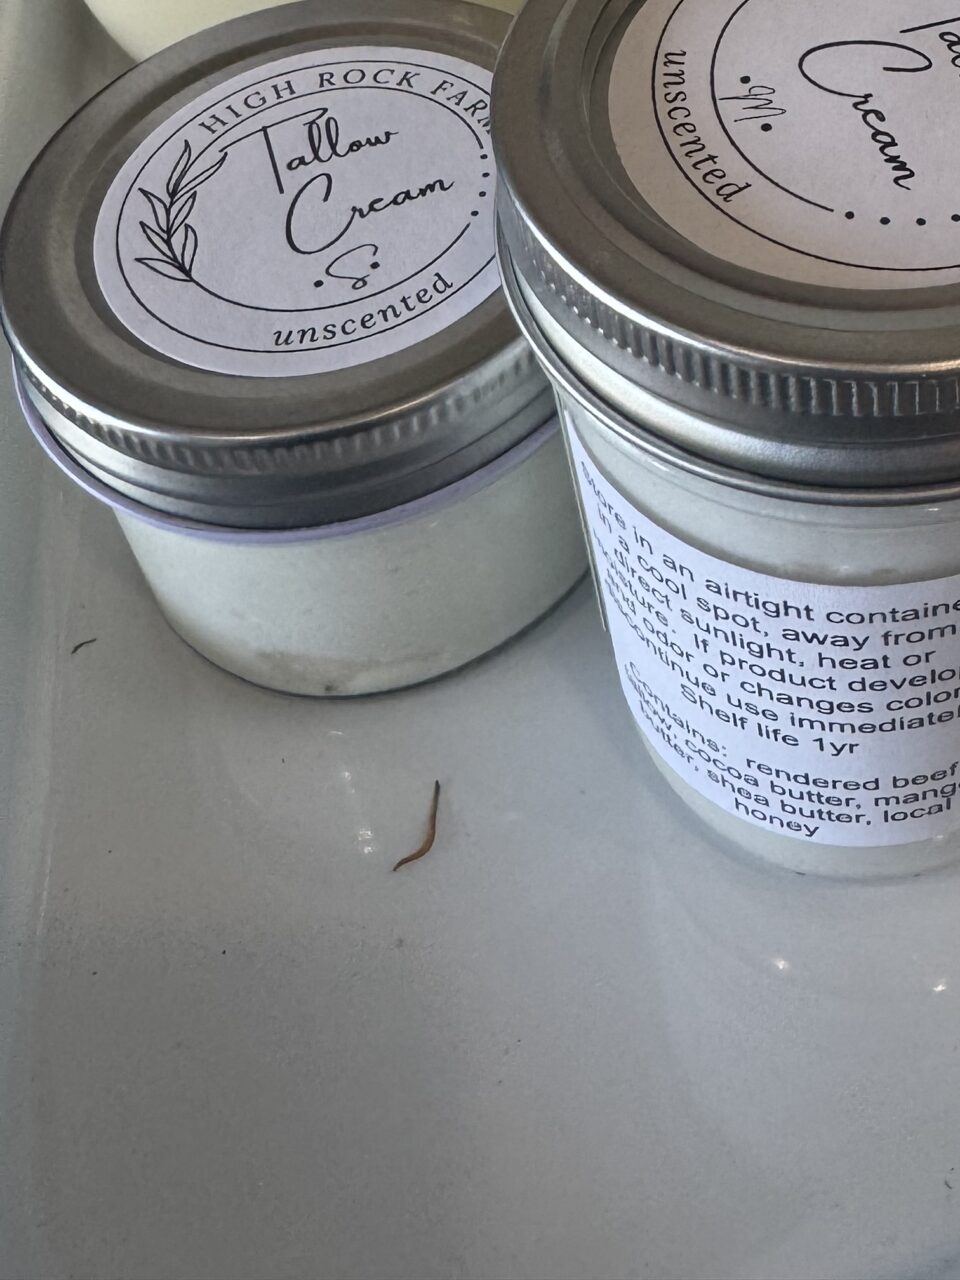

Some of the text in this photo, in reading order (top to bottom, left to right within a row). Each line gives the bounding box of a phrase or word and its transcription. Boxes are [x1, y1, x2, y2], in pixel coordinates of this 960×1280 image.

[198, 80, 296, 135] HIGH
[318, 68, 421, 89] ROCK
[662, 48, 753, 203] unscented
[799, 40, 932, 191] Cream
[219, 107, 399, 194] Tallow
[285, 172, 455, 254] Cream
[273, 272, 454, 347] unscented
[614, 548, 936, 670] direct sunlight, heat or
[618, 535, 630, 554] a
[637, 555, 687, 600] cool
[697, 597, 769, 637] spot,
[782, 628, 870, 651] away
[881, 624, 957, 646] from
[633, 526, 653, 555] in
[662, 554, 694, 582] an
[705, 579, 815, 620] airtight
[643, 618, 695, 662] odor
[703, 663, 730, 682] or
[740, 681, 874, 715] changes
[694, 633, 709, 653] If
[720, 650, 837, 691] product
[629, 661, 959, 791] Contains: rendered beef
[680, 683, 860, 757] Shelf life 1yr
[727, 693, 779, 721] use
[685, 739, 759, 787] cocoa
[770, 780, 862, 809] butter,
[707, 770, 770, 807] shea
[781, 799, 872, 826] butter,
[883, 797, 952, 823] local
[735, 797, 820, 838] honey
